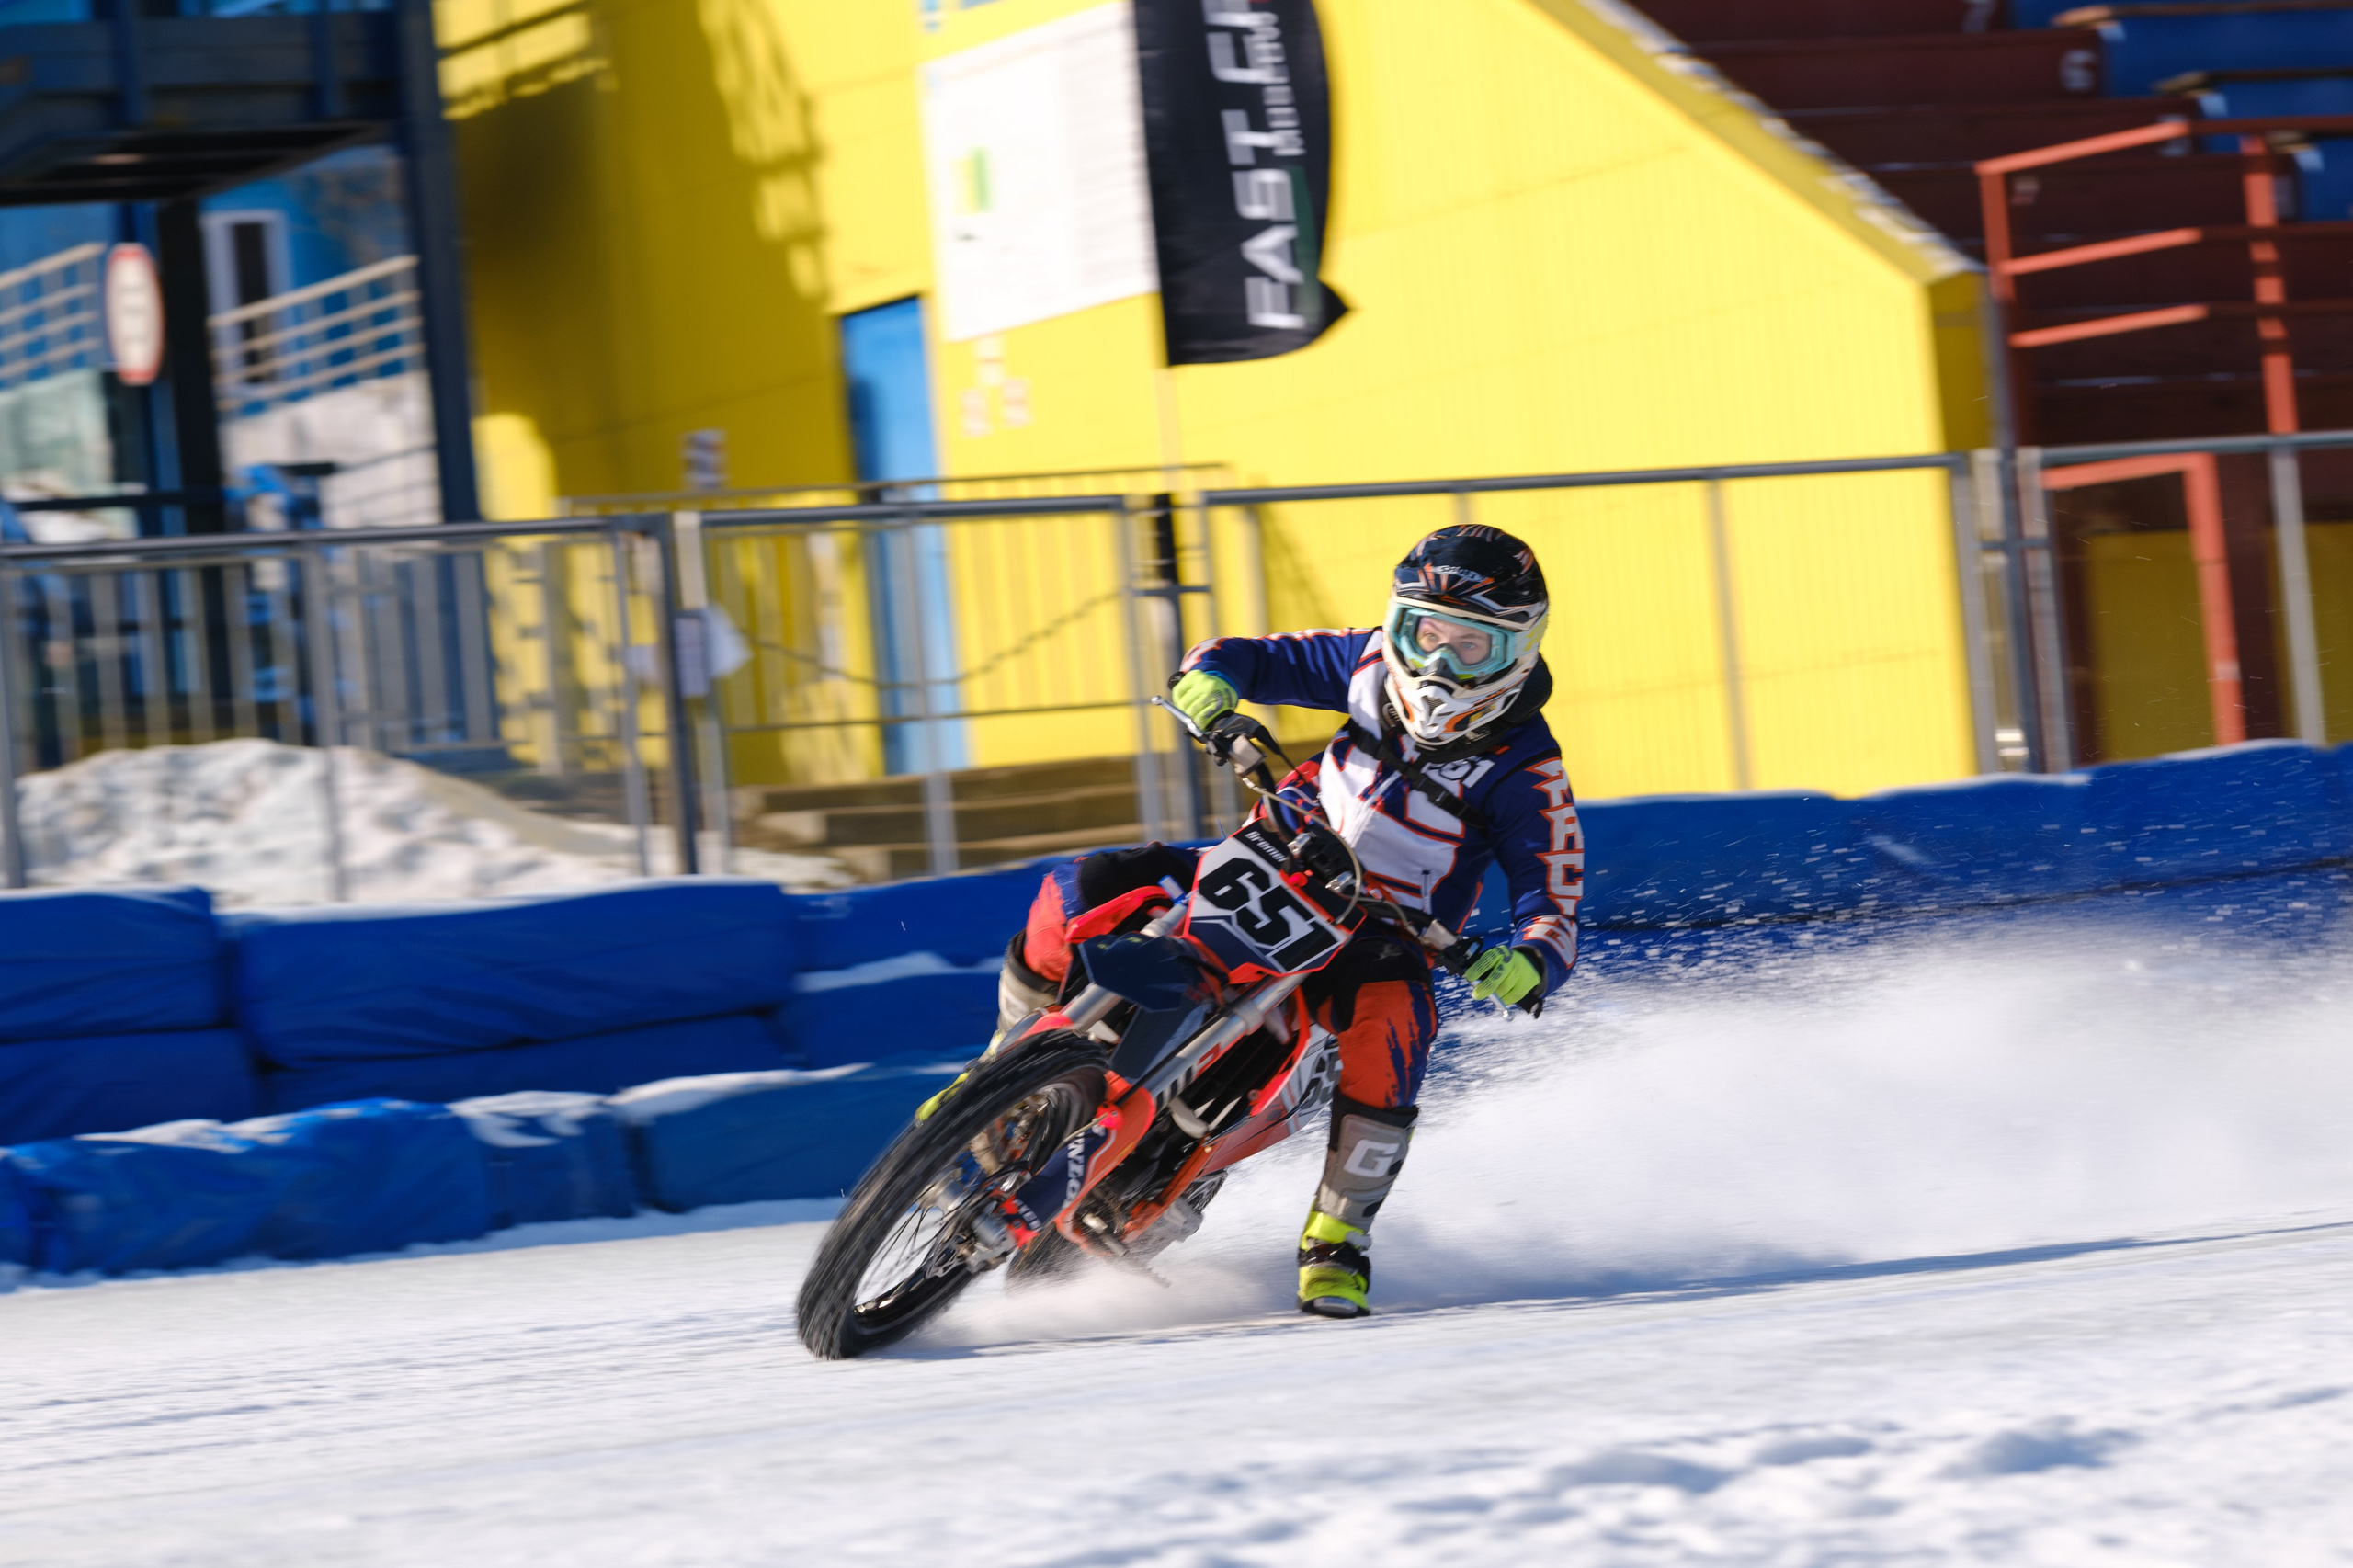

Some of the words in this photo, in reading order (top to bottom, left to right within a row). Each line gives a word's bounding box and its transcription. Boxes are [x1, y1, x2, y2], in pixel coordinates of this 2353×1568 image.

[1222, 109, 1306, 329] FAST
[1198, 857, 1340, 971] 651
[1343, 1138, 1401, 1178] G
